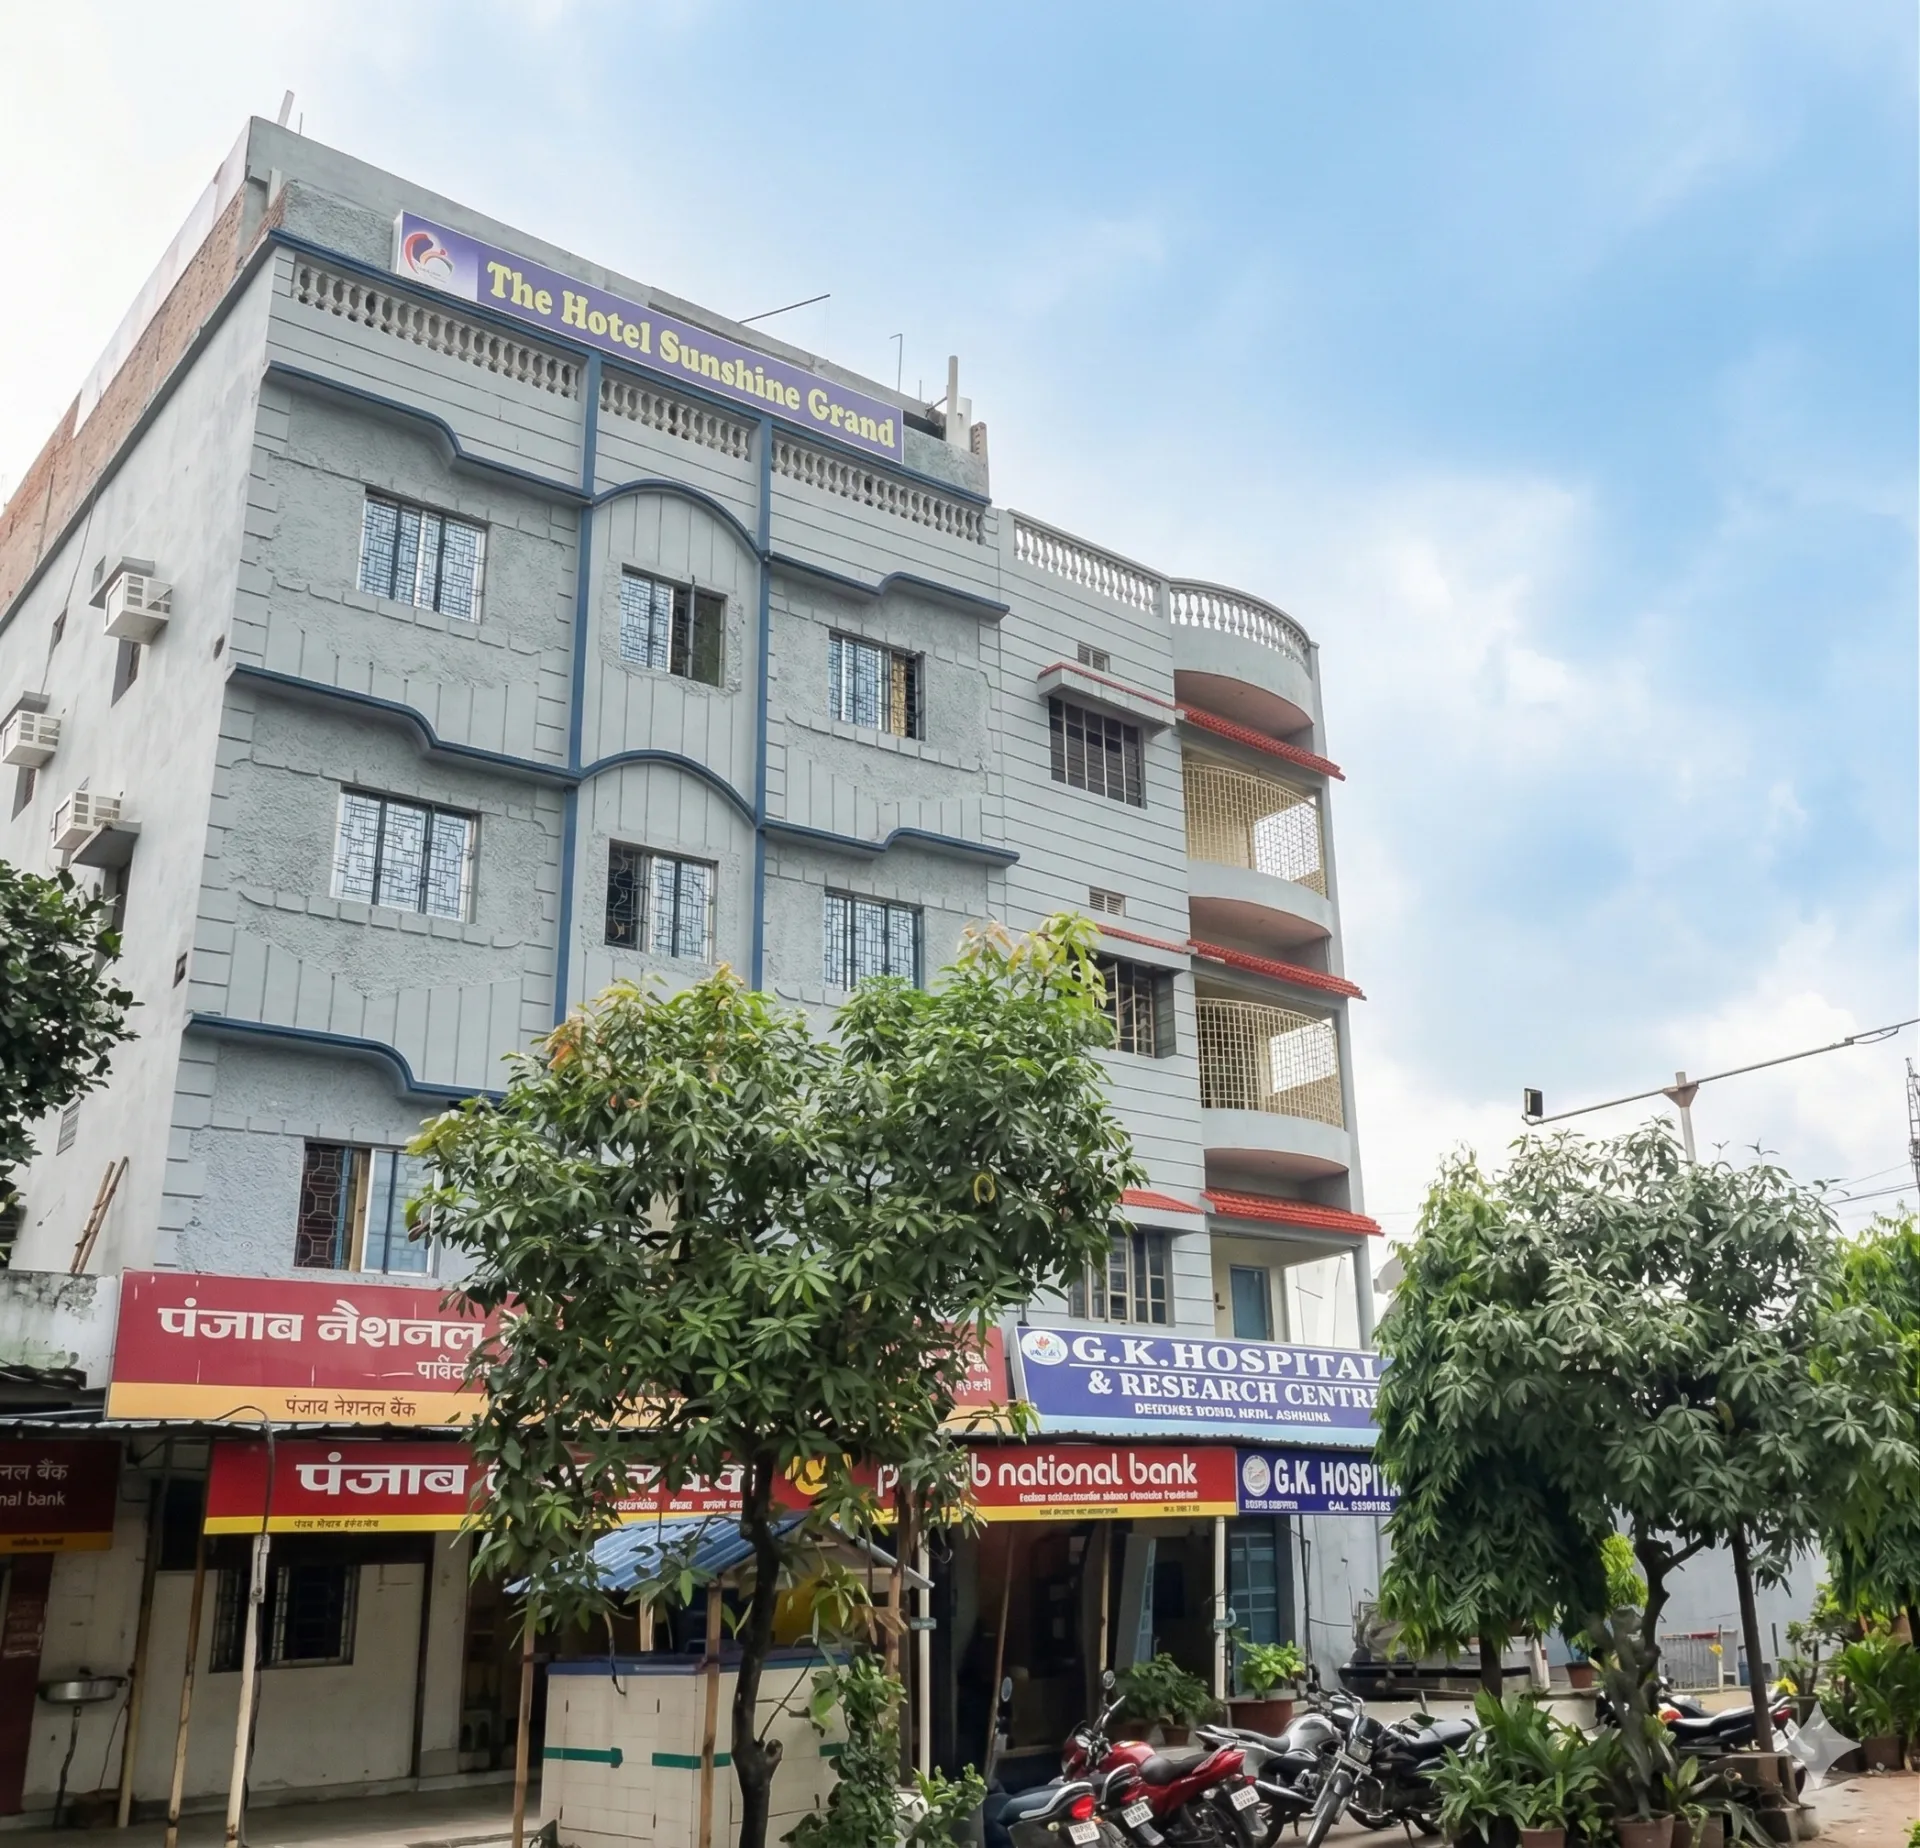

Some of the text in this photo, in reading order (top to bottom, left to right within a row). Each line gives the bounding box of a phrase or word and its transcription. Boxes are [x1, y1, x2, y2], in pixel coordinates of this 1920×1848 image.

[487, 261, 896, 449] The Hotel Sunshine Grand
[157, 1297, 486, 1350] पंजाब नैशनल
[1088, 1370, 1113, 1395] &
[1119, 1372, 1279, 1404] RESEARCH
[36, 1458, 69, 1480] बैंक
[295, 1451, 469, 1496] पंजाब
[998, 1453, 1123, 1486] national
[1129, 1452, 1198, 1485] bank
[1274, 1458, 1316, 1495] G.K.
[27, 1490, 66, 1506] bank
